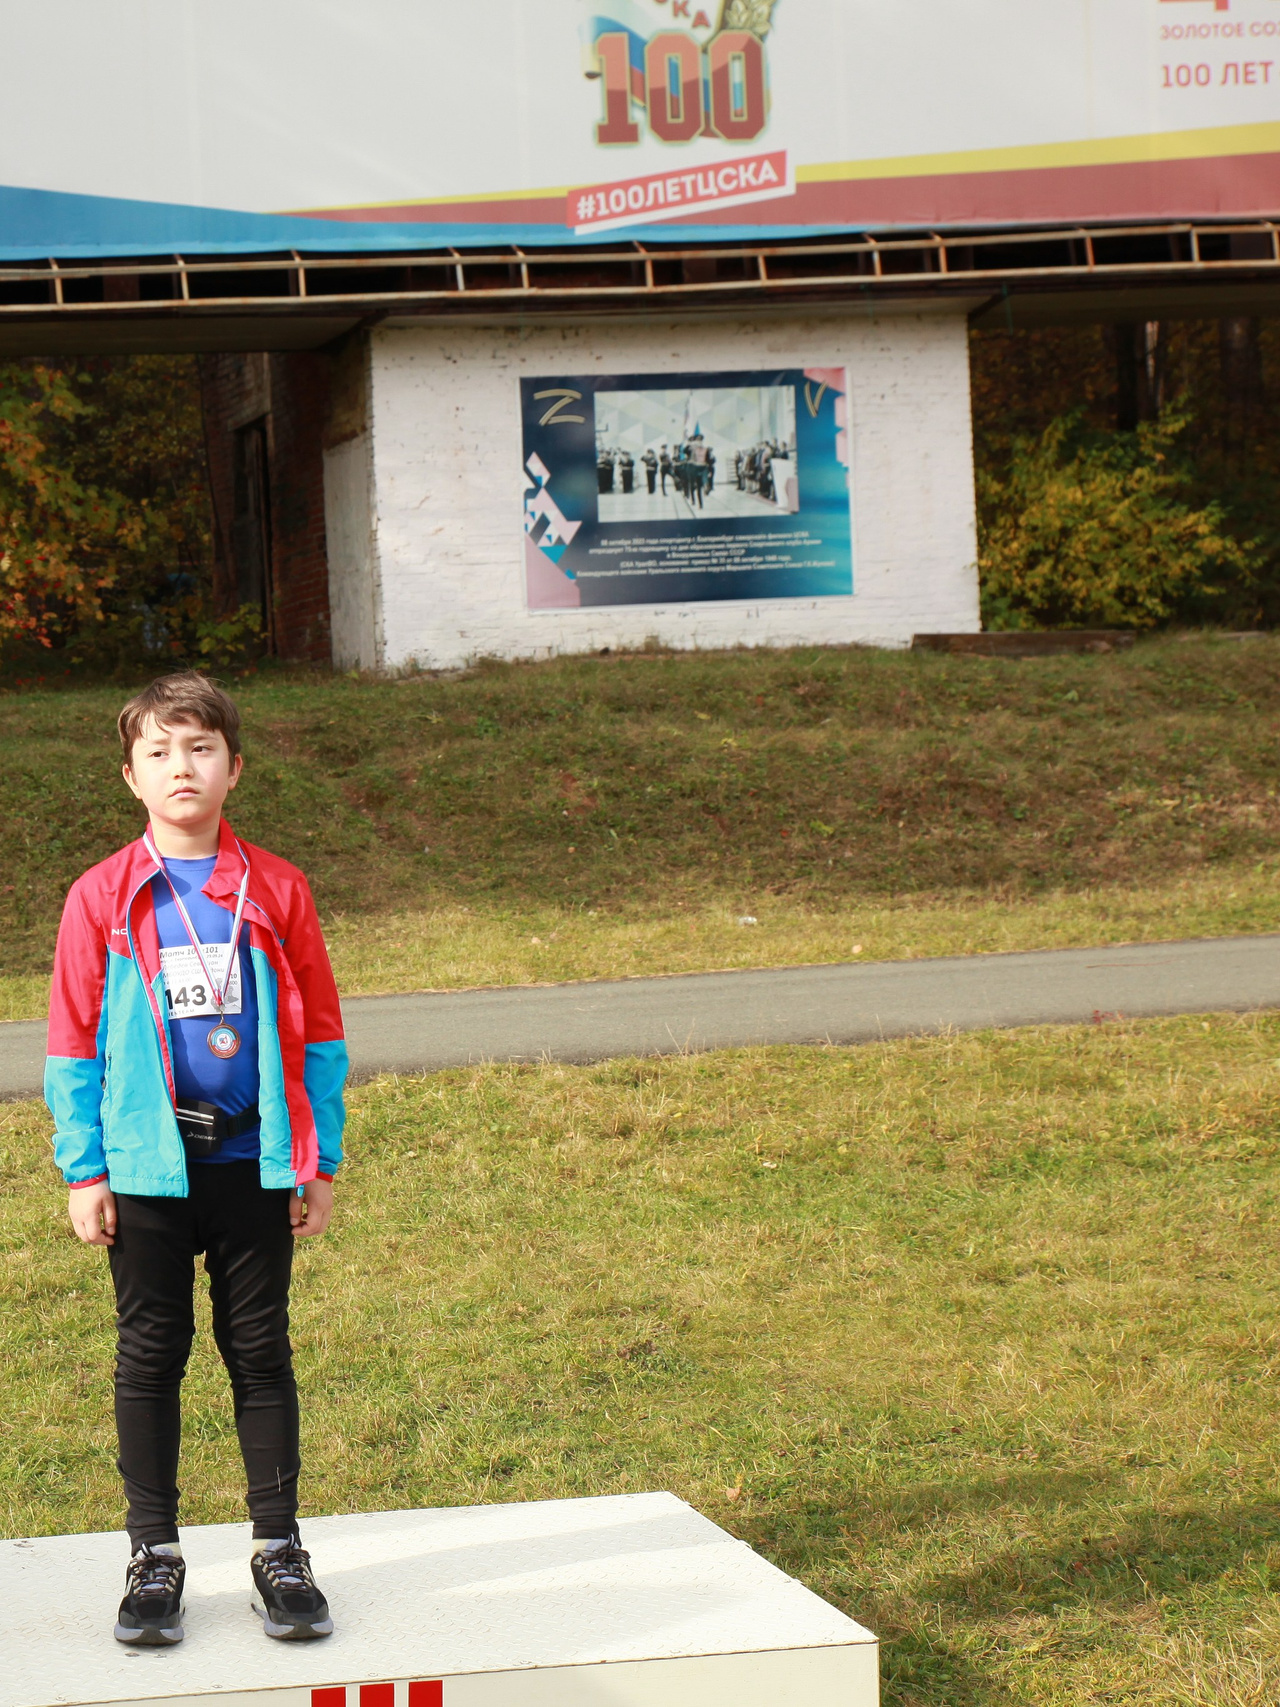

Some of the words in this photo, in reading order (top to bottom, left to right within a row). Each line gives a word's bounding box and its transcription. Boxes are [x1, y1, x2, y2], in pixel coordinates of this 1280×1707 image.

[1160, 21, 1245, 40] ЗОЛОТОЕ
[1249, 20, 1280, 37] СО
[593, 30, 767, 146] 100
[1161, 62, 1211, 89] 100
[1220, 60, 1274, 86] ЛЕТ
[576, 159, 779, 221] #100ЛЕТЦСКА
[532, 387, 587, 427] Z
[803, 380, 829, 418] V
[164, 984, 207, 1011] 143
